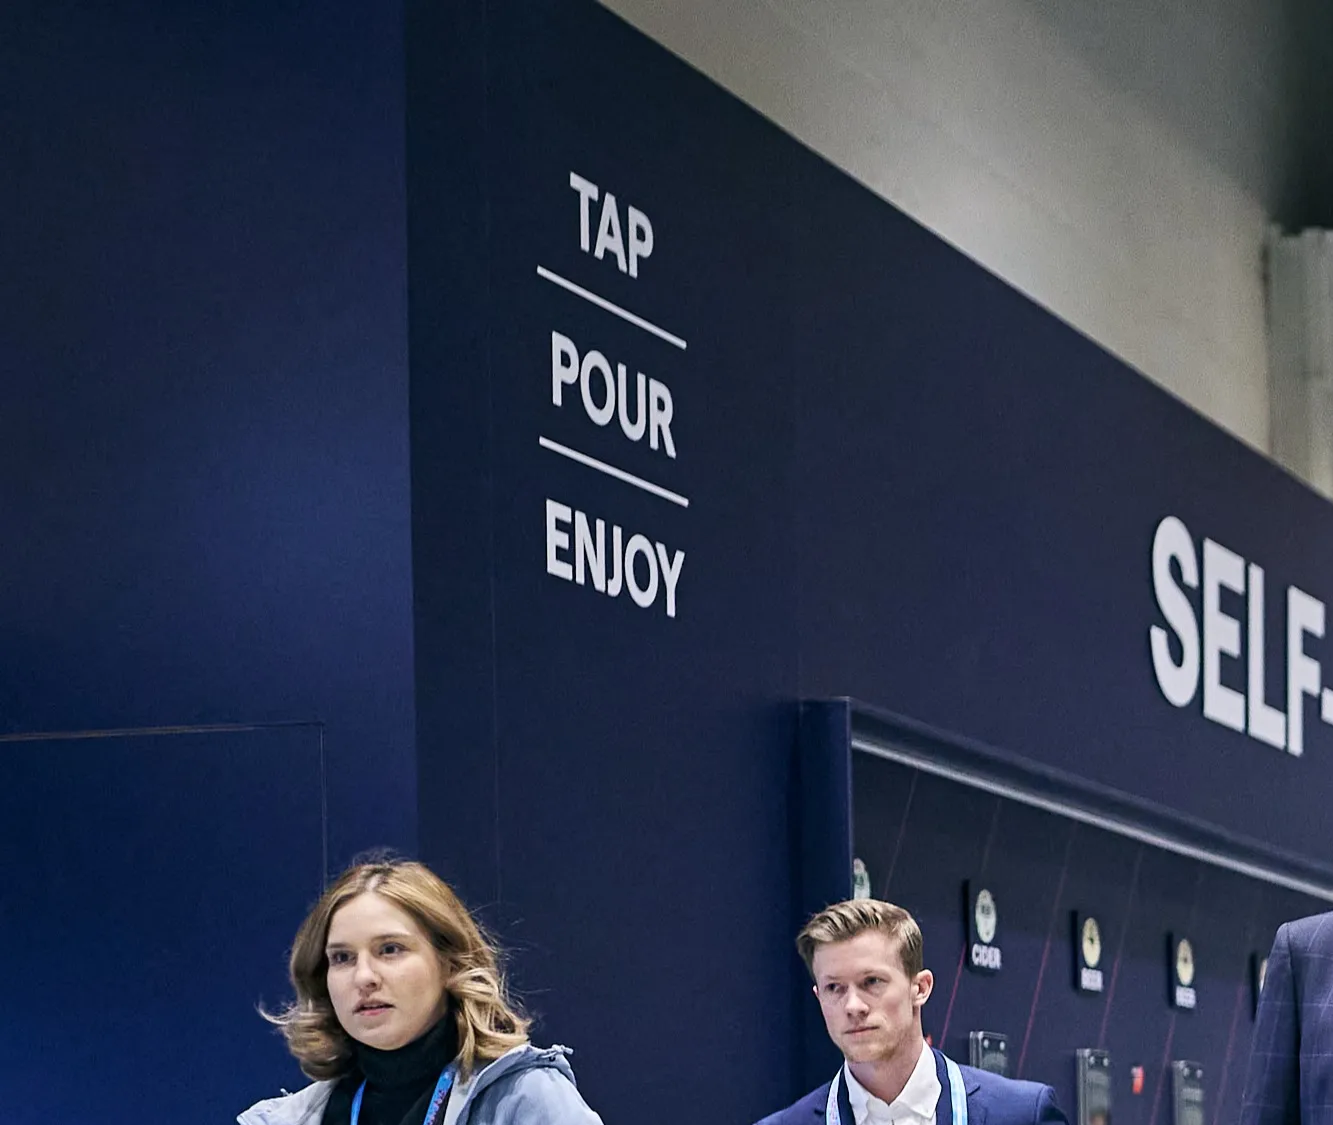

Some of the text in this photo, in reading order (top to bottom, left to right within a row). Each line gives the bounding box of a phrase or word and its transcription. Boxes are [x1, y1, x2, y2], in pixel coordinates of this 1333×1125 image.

[570, 171, 654, 278] TAP
[552, 330, 676, 458] POUR
[546, 498, 685, 618] ENJOY
[971, 943, 1002, 970] CIDER
